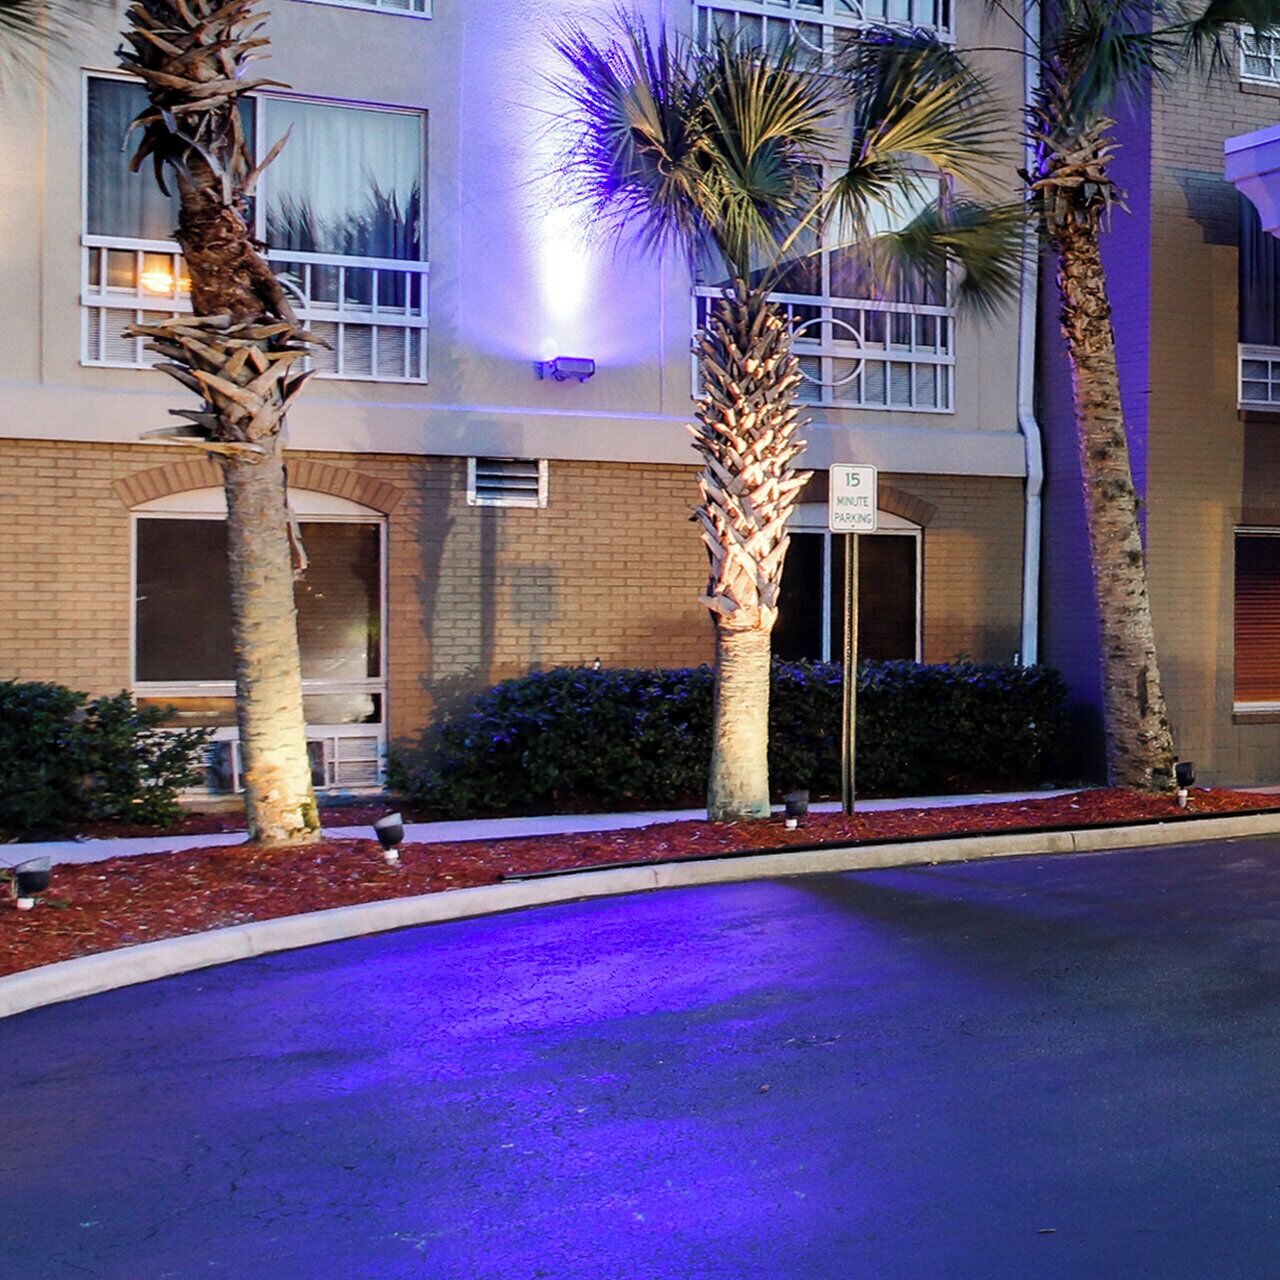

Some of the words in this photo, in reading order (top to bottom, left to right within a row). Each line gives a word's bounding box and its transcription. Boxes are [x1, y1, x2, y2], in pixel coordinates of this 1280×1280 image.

[846, 472, 861, 487] 15
[837, 496, 869, 507] MINUTE
[834, 512, 872, 524] PARKING
